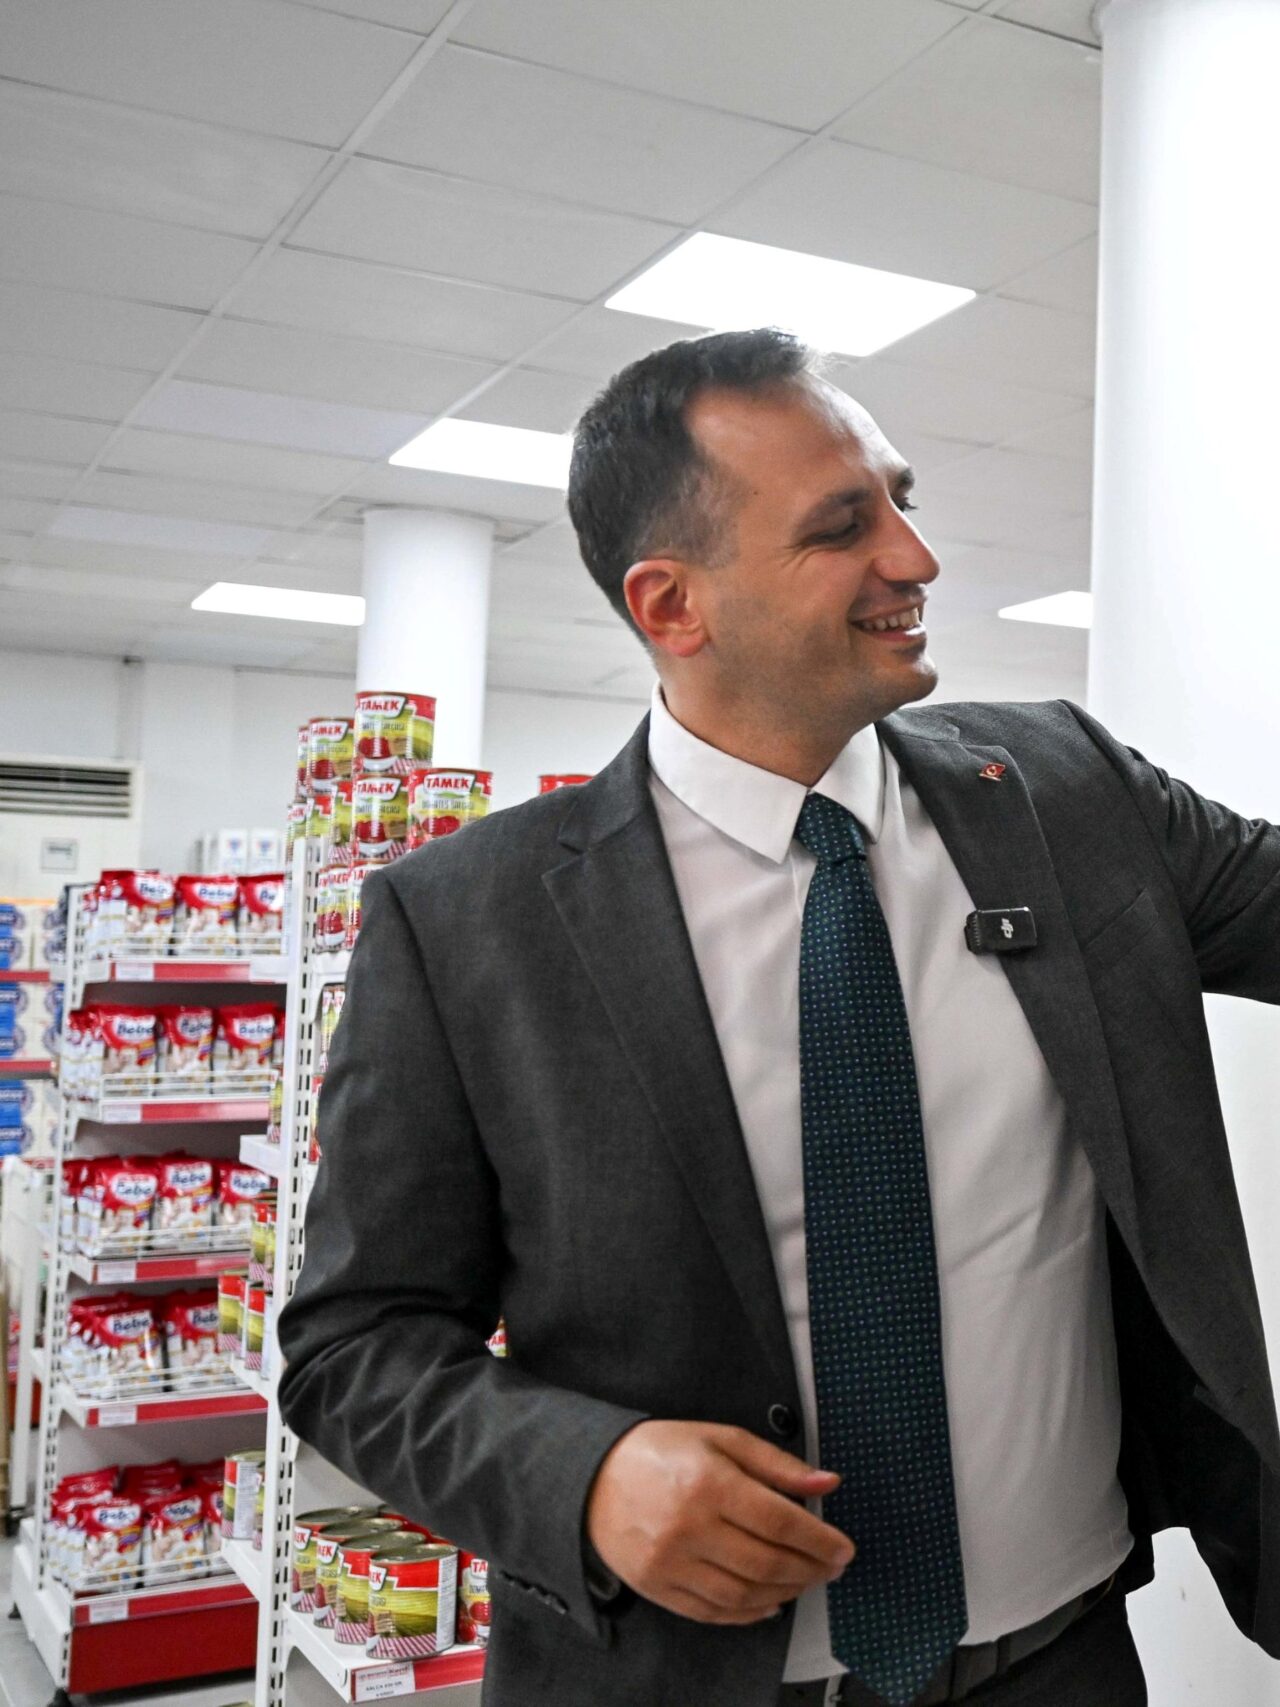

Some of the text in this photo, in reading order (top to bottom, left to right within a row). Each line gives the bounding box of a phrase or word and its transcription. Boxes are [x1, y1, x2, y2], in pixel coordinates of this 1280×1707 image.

[361, 699, 399, 711] TAMEK
[357, 782, 394, 793] TAMEK
[425, 777, 469, 789] TAMEK
